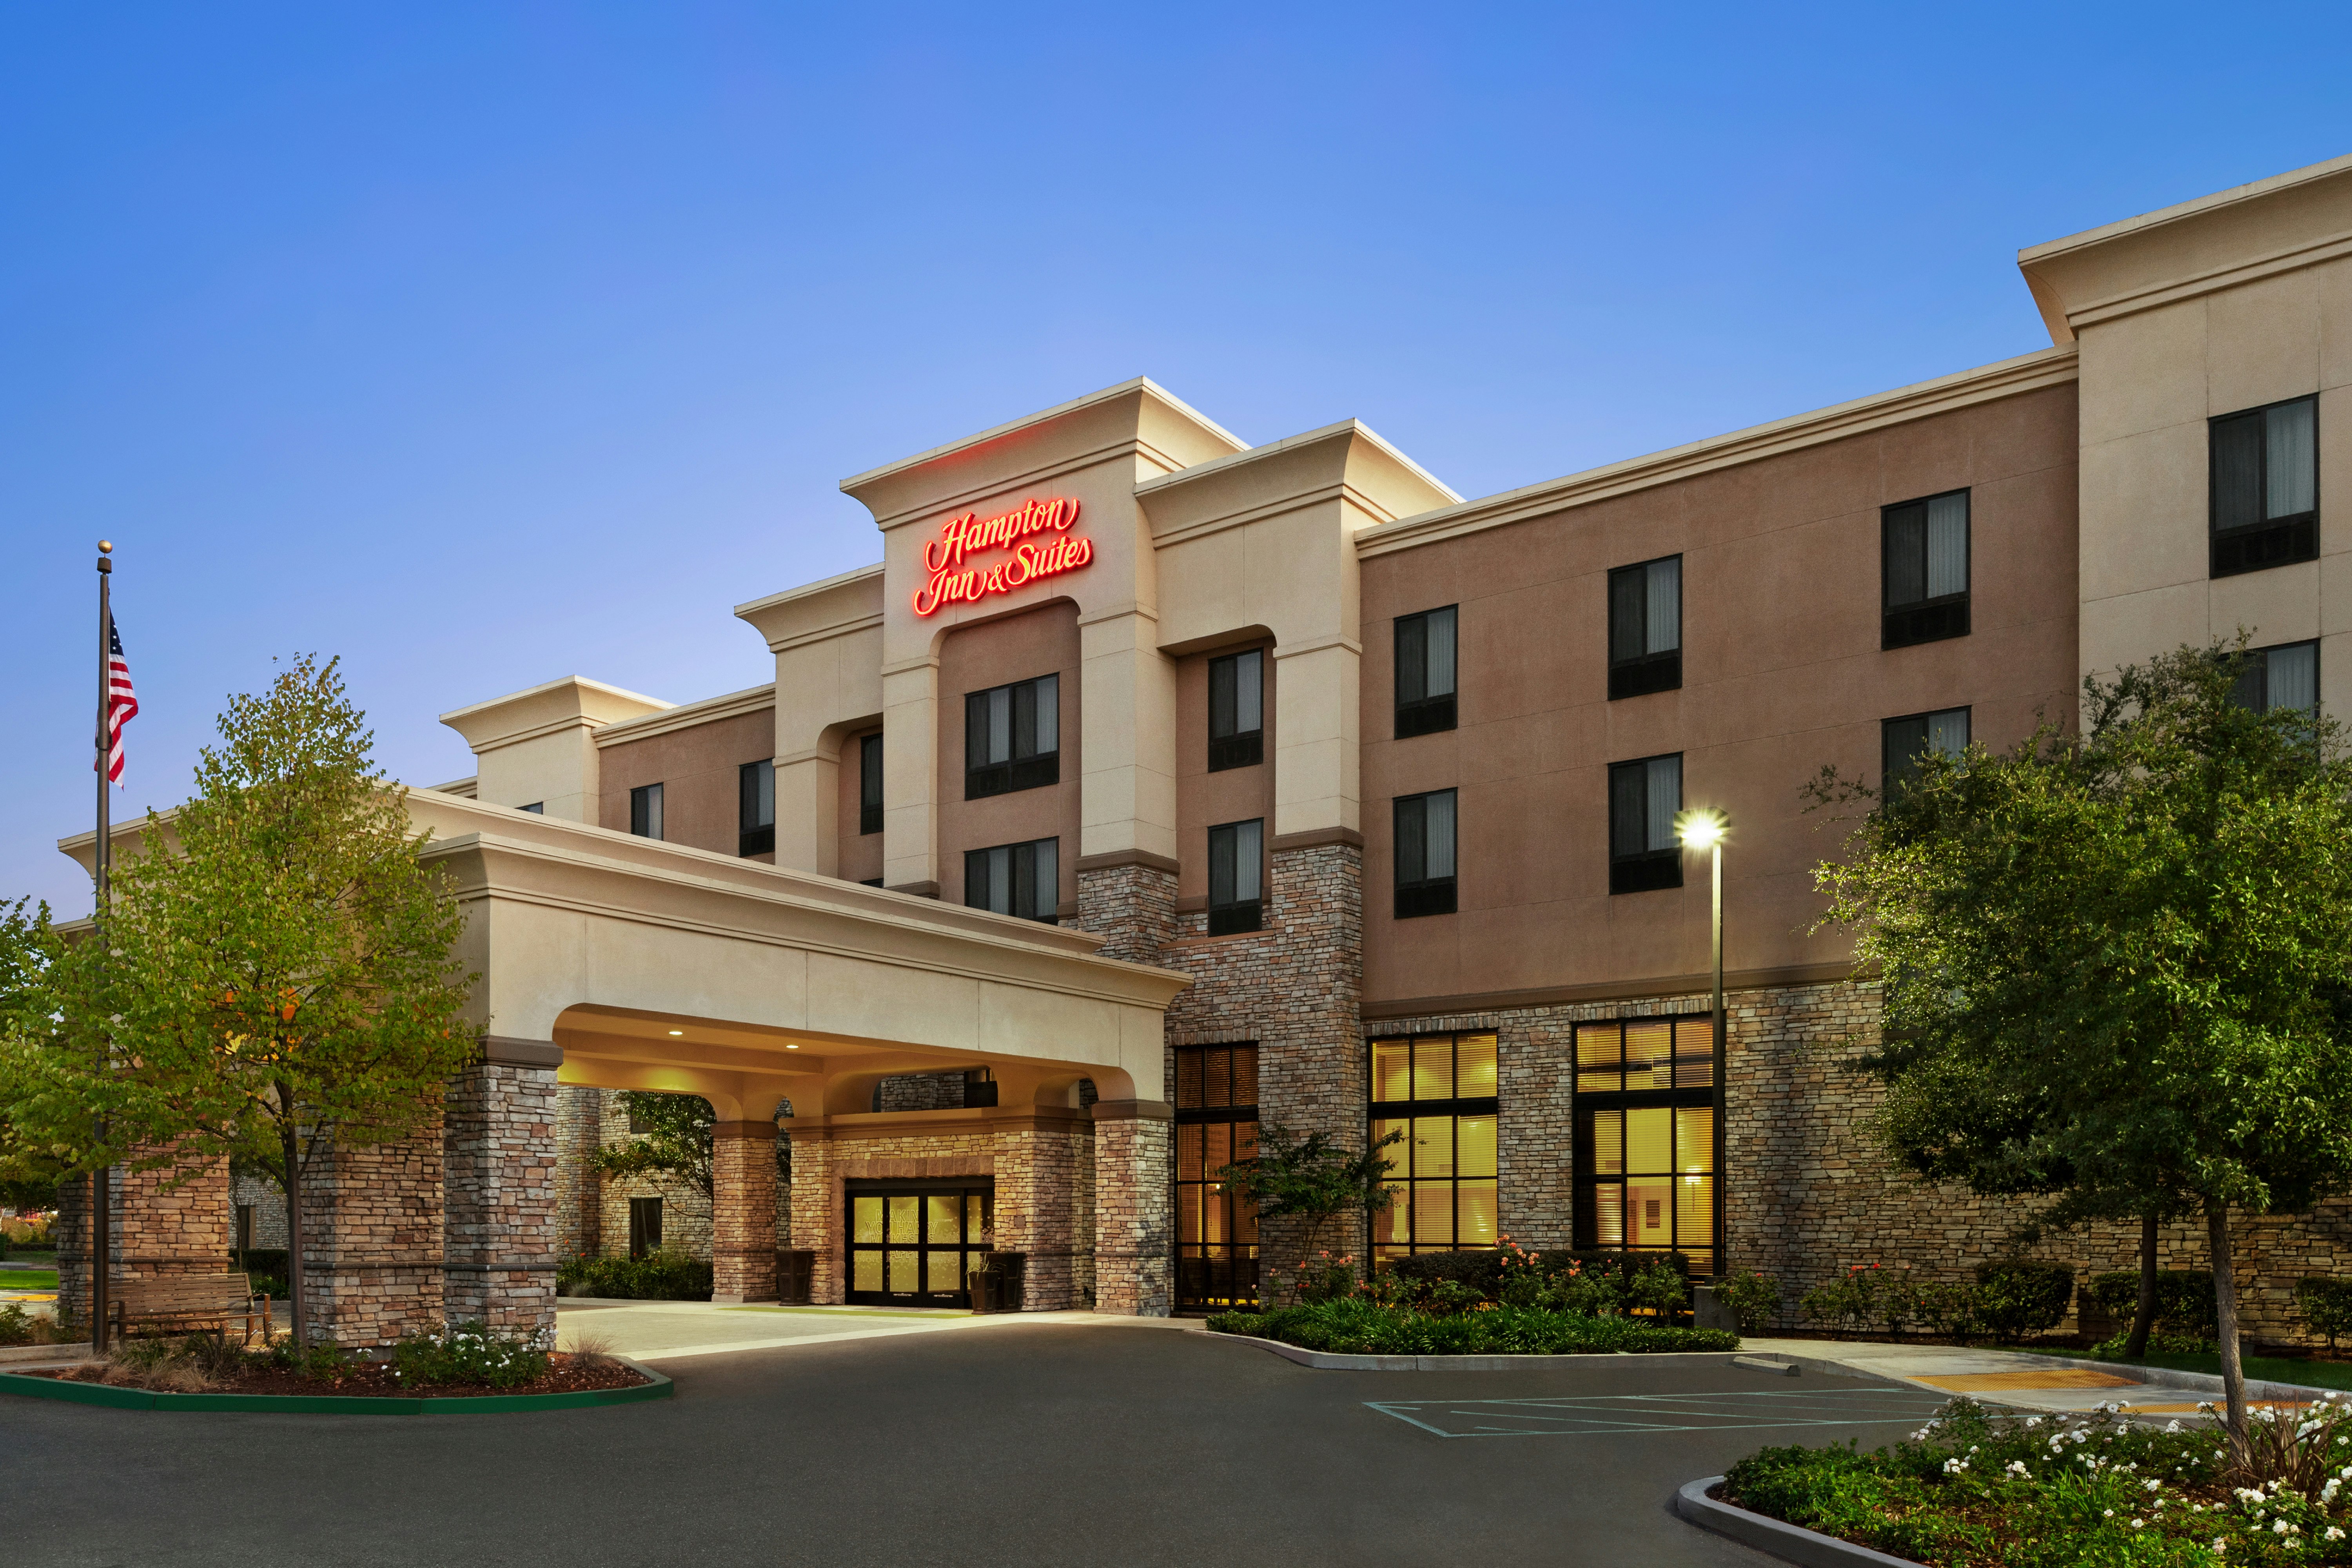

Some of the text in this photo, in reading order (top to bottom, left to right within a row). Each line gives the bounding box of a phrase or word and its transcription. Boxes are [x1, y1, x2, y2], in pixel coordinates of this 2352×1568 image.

[926, 498, 1080, 572] Hampton
[913, 536, 1093, 615] Inn & Suites
[875, 1209, 919, 1222] MAKIN
[897, 1221, 938, 1235] HAY
[869, 1234, 915, 1243] MKES
[879, 1250, 919, 1259] APP
